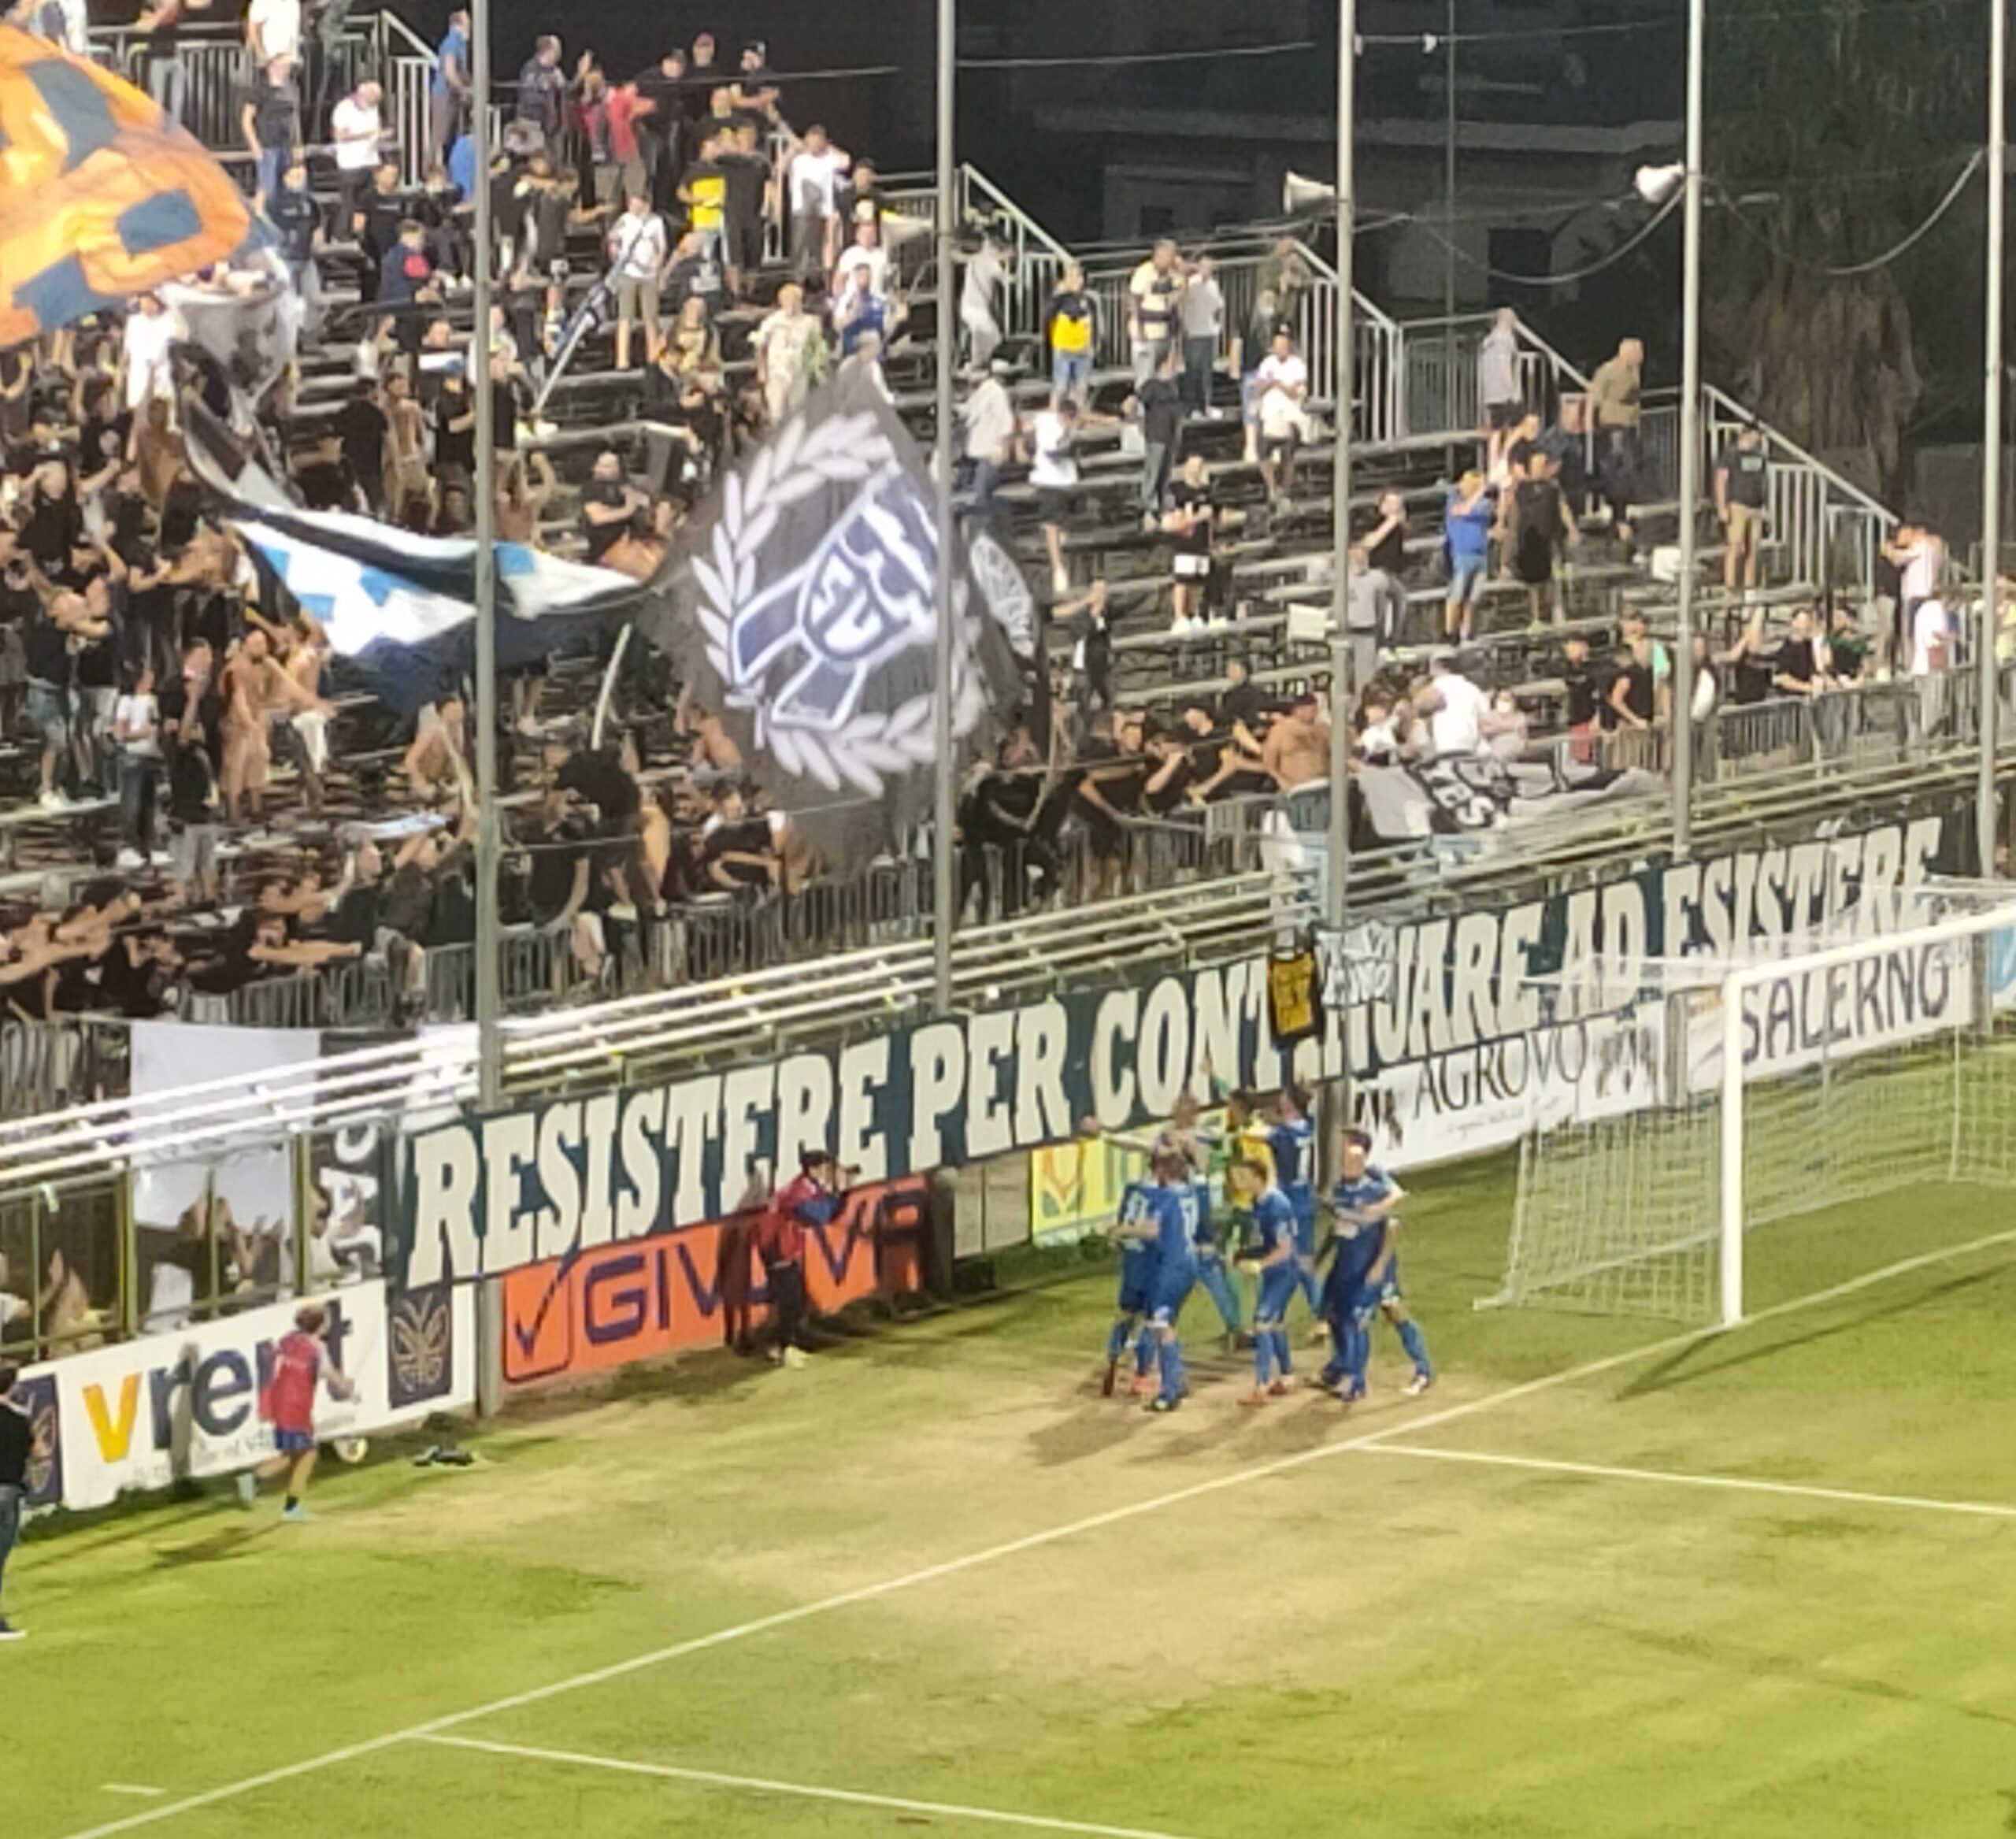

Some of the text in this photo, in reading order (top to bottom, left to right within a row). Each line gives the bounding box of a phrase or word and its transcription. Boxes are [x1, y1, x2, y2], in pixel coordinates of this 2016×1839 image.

[407, 1034, 891, 1289] RESISTERE
[910, 1001, 1072, 1172] PER
[1557, 882, 1647, 1021] AD
[1663, 817, 1944, 984] ESISTERE
[584, 1188, 931, 1346] GIVVA
